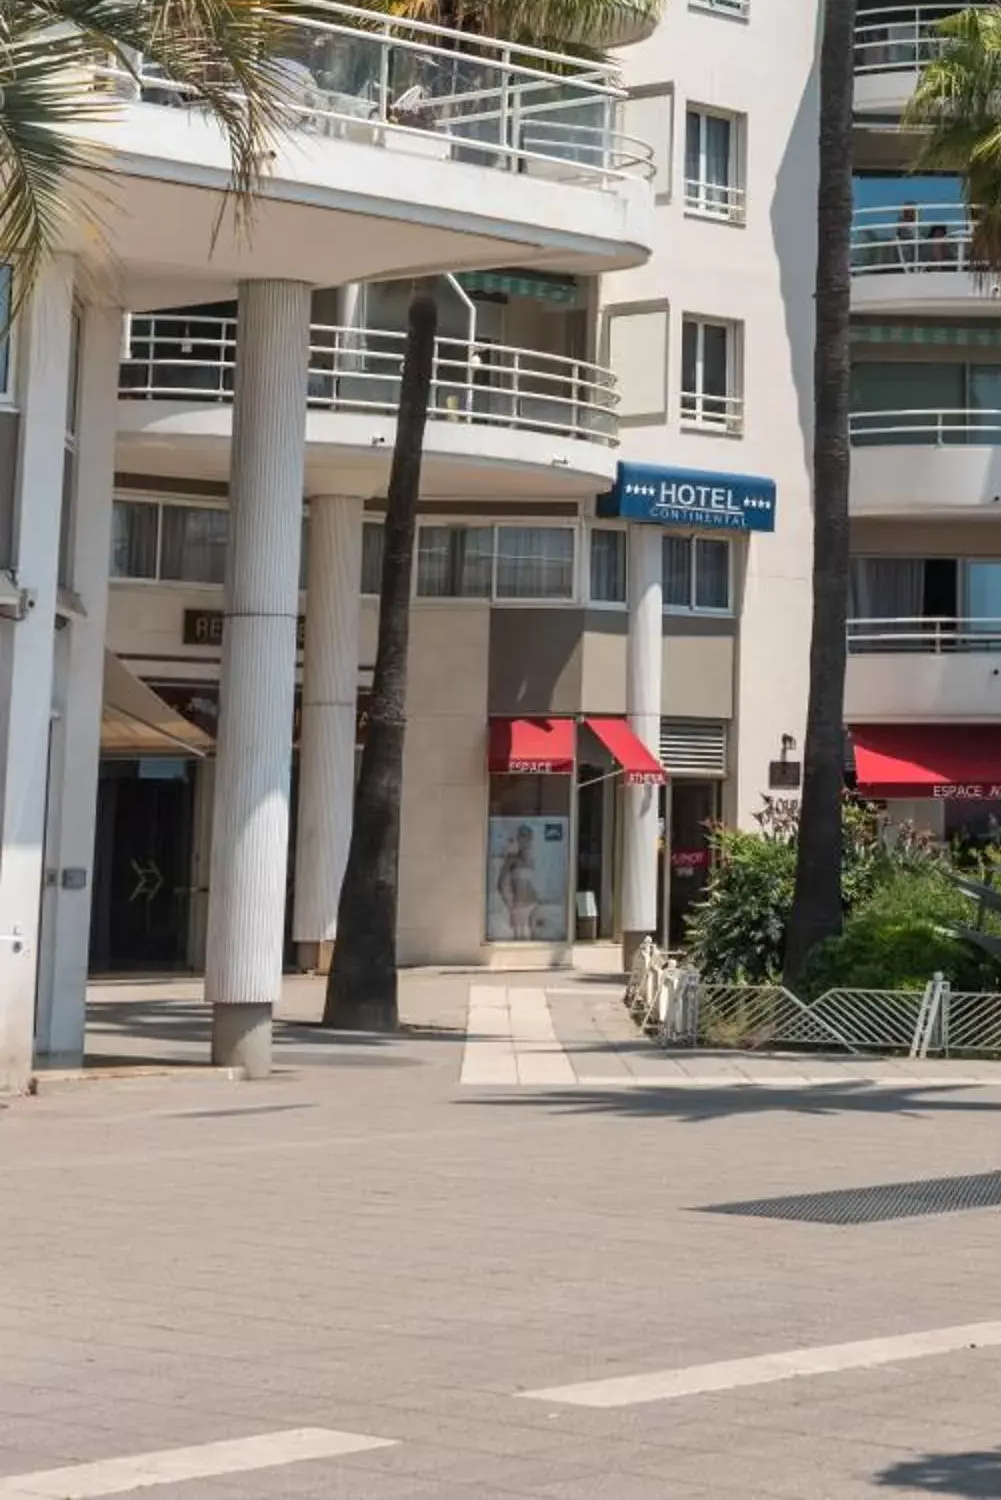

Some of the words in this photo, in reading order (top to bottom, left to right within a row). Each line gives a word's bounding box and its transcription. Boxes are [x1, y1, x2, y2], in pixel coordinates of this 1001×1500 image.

[659, 481, 741, 510] HOTEL
[650, 508, 748, 529] CONTINENTAL
[509, 761, 552, 773] ESPACE
[933, 784, 983, 798] ESPACE
